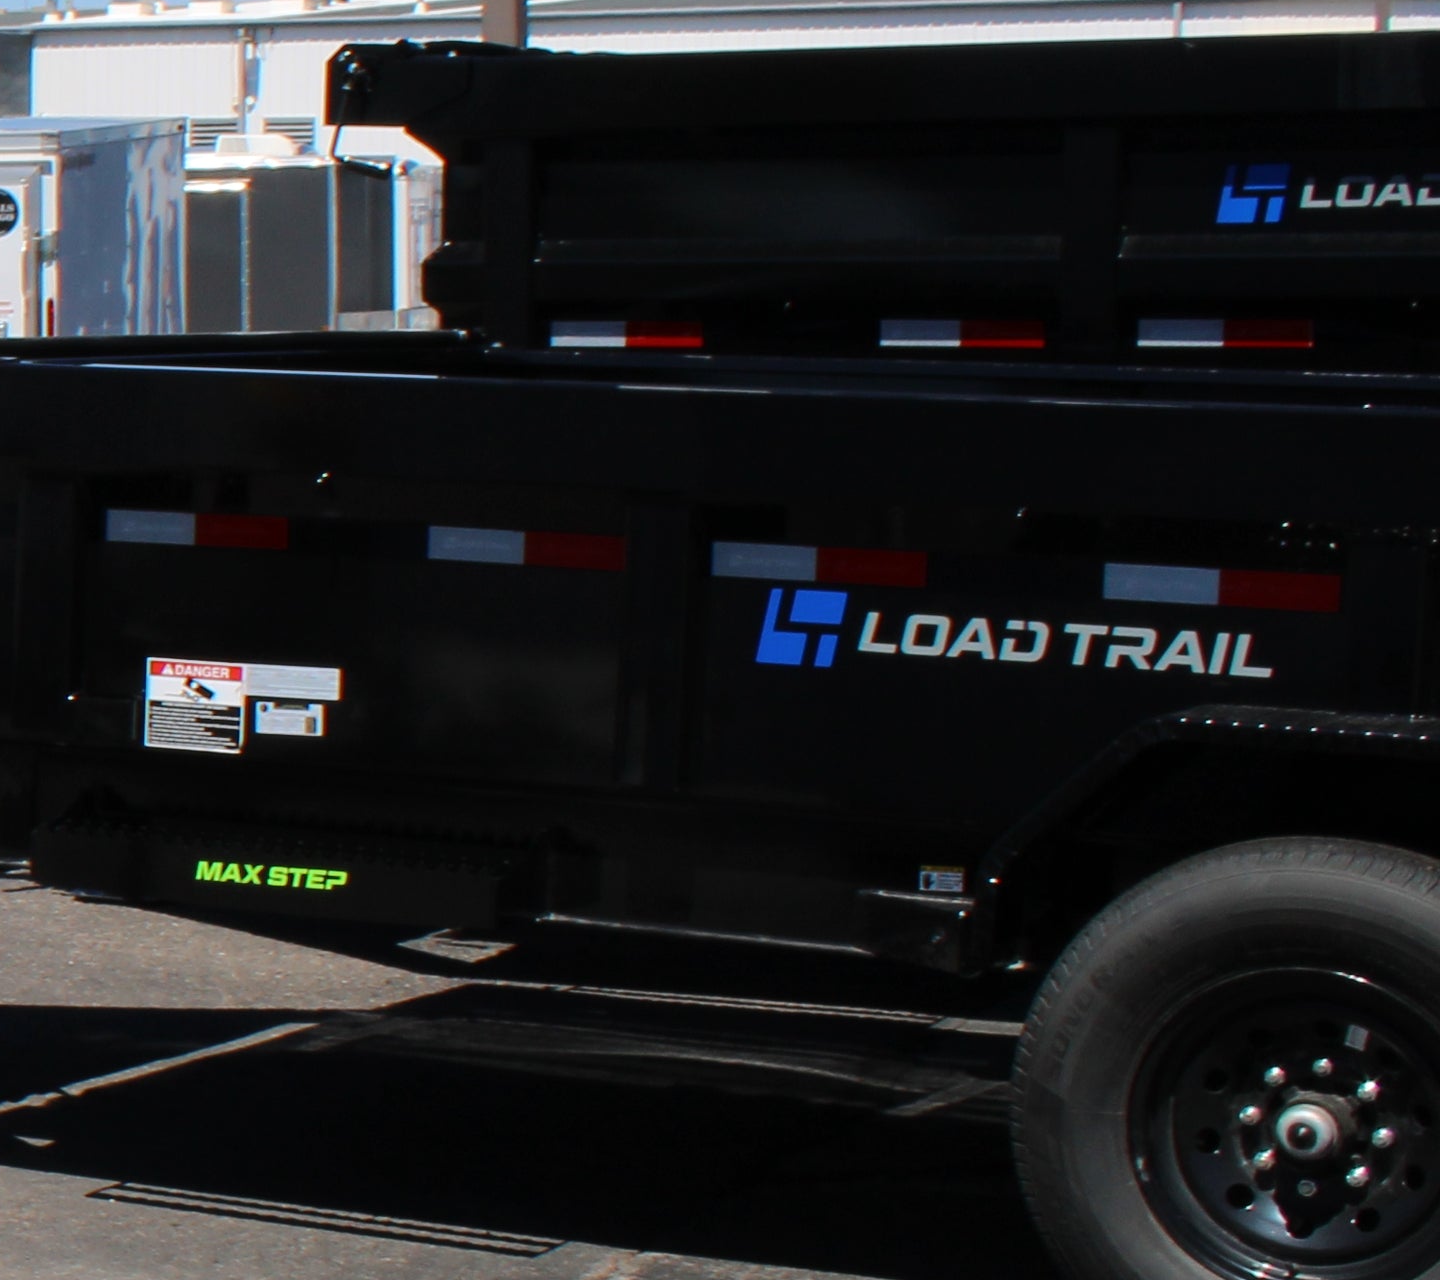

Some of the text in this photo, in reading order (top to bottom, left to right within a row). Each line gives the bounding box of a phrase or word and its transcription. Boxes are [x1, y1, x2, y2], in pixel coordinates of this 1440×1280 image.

[857, 611, 1273, 679] LOAD TRAIL
[174, 663, 230, 679] DANGER
[195, 860, 348, 890] MAX STEP
